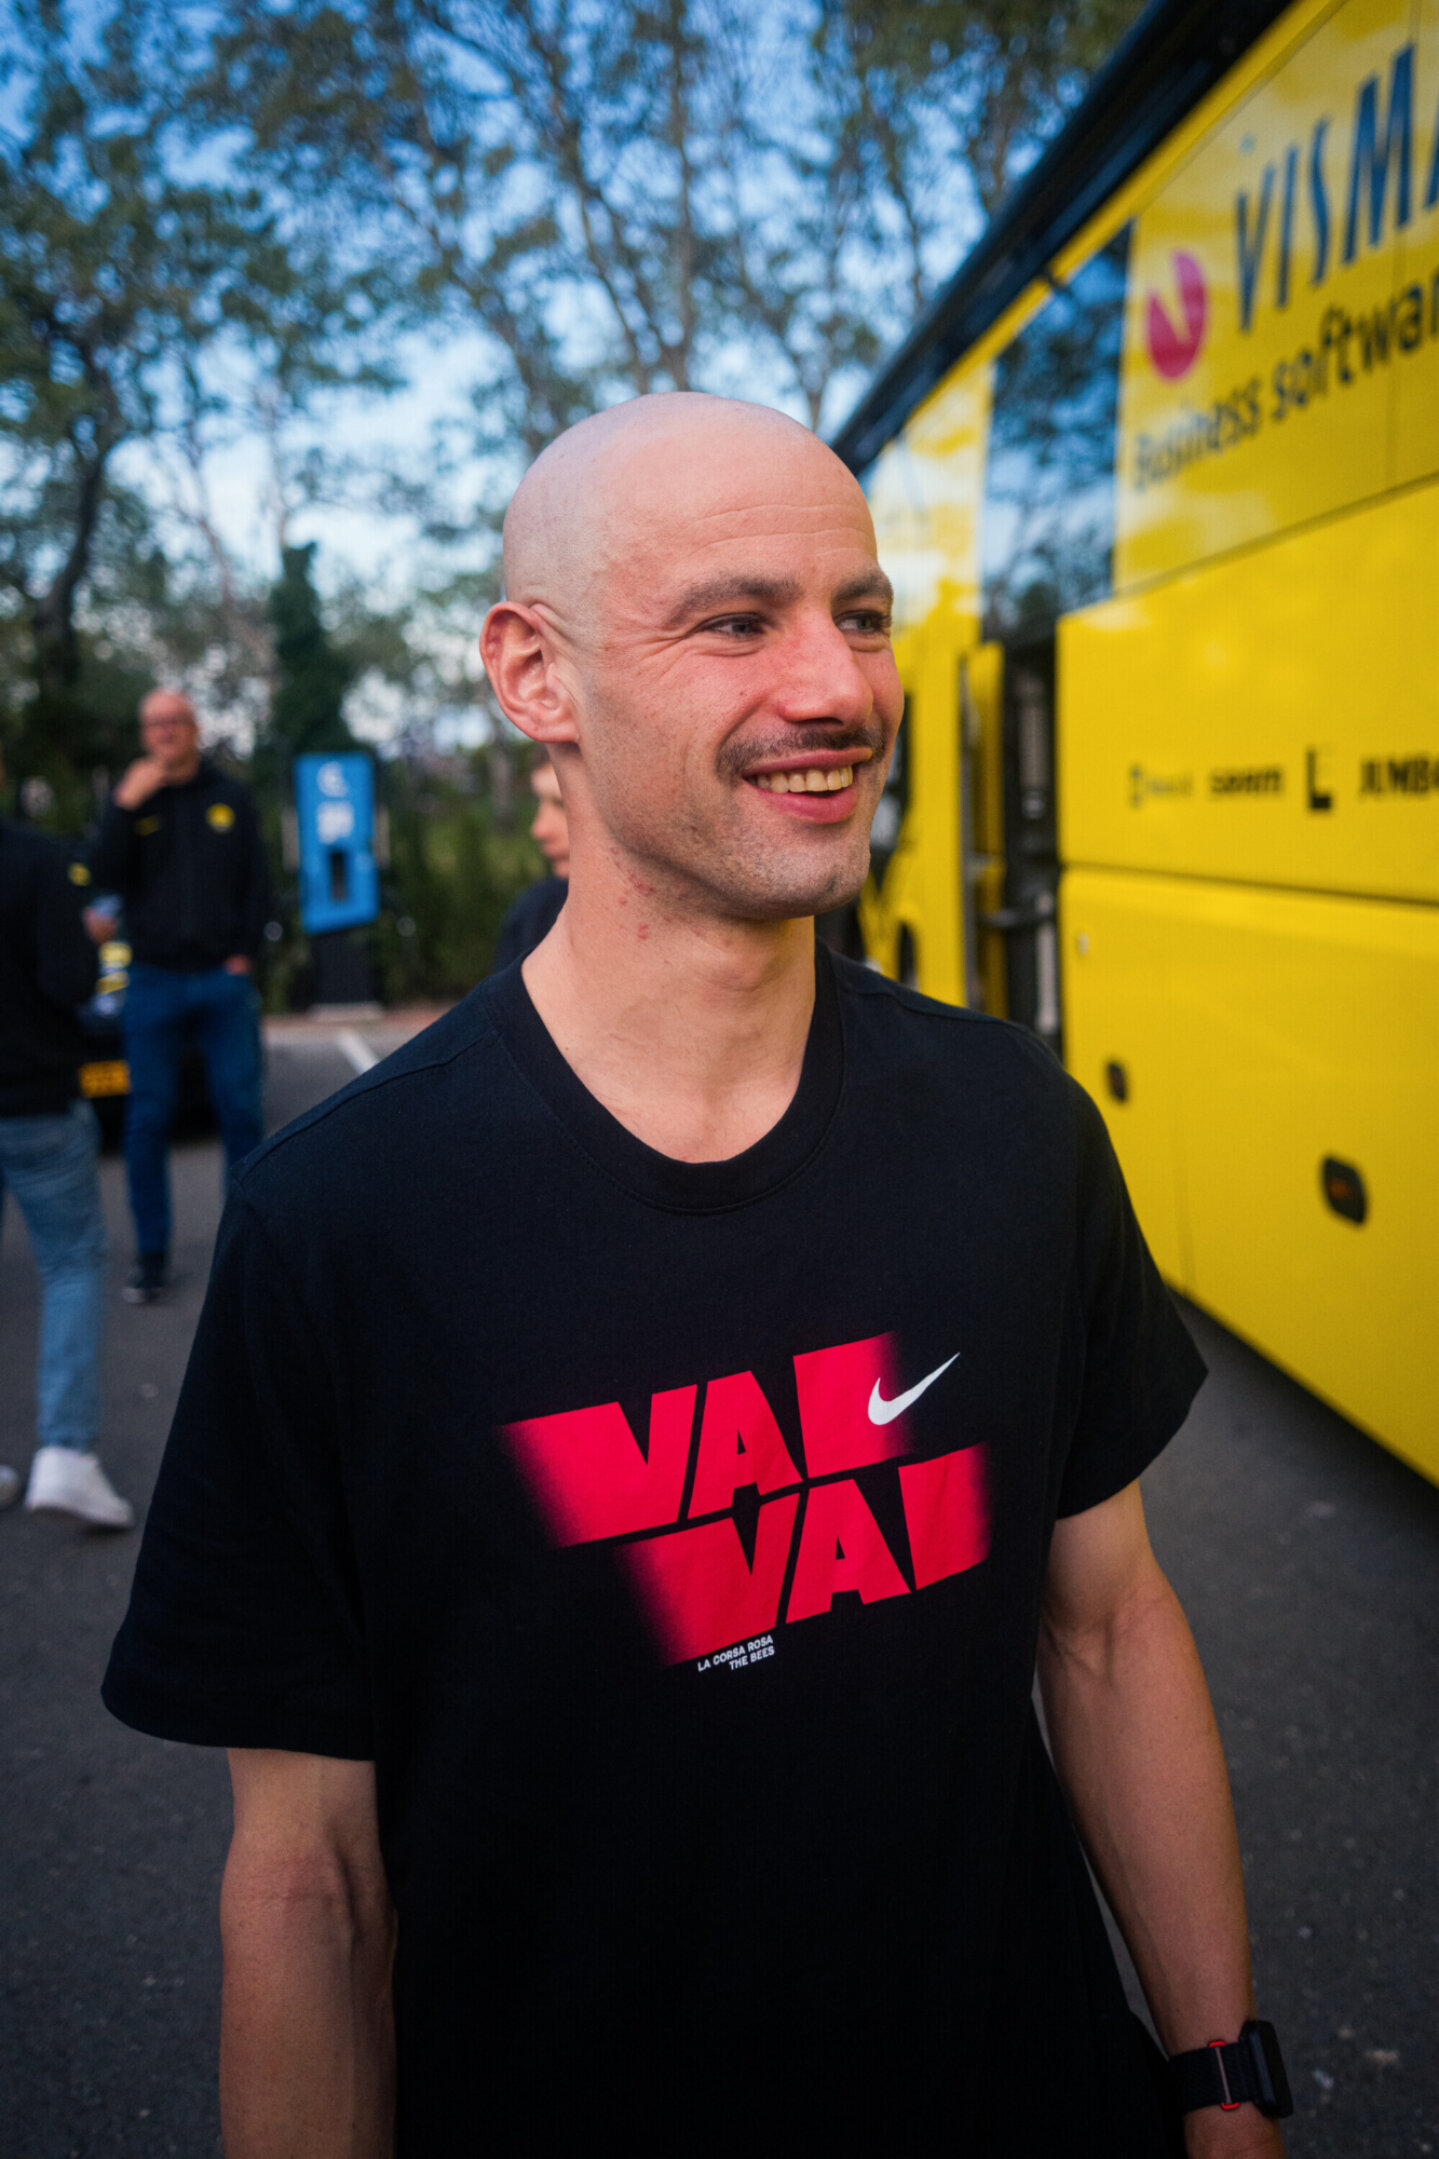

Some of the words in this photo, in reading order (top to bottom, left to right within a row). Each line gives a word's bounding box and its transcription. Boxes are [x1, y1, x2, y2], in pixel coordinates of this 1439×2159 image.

[1235, 42, 1439, 335] VISM
[498, 1330, 908, 1548] VAI
[615, 1441, 991, 1667] VAI
[697, 1659, 711, 1672] LA
[713, 1645, 746, 1665] CORSA
[747, 1634, 773, 1652] ROSA
[729, 1656, 748, 1670] THE
[750, 1645, 775, 1663] BEES
